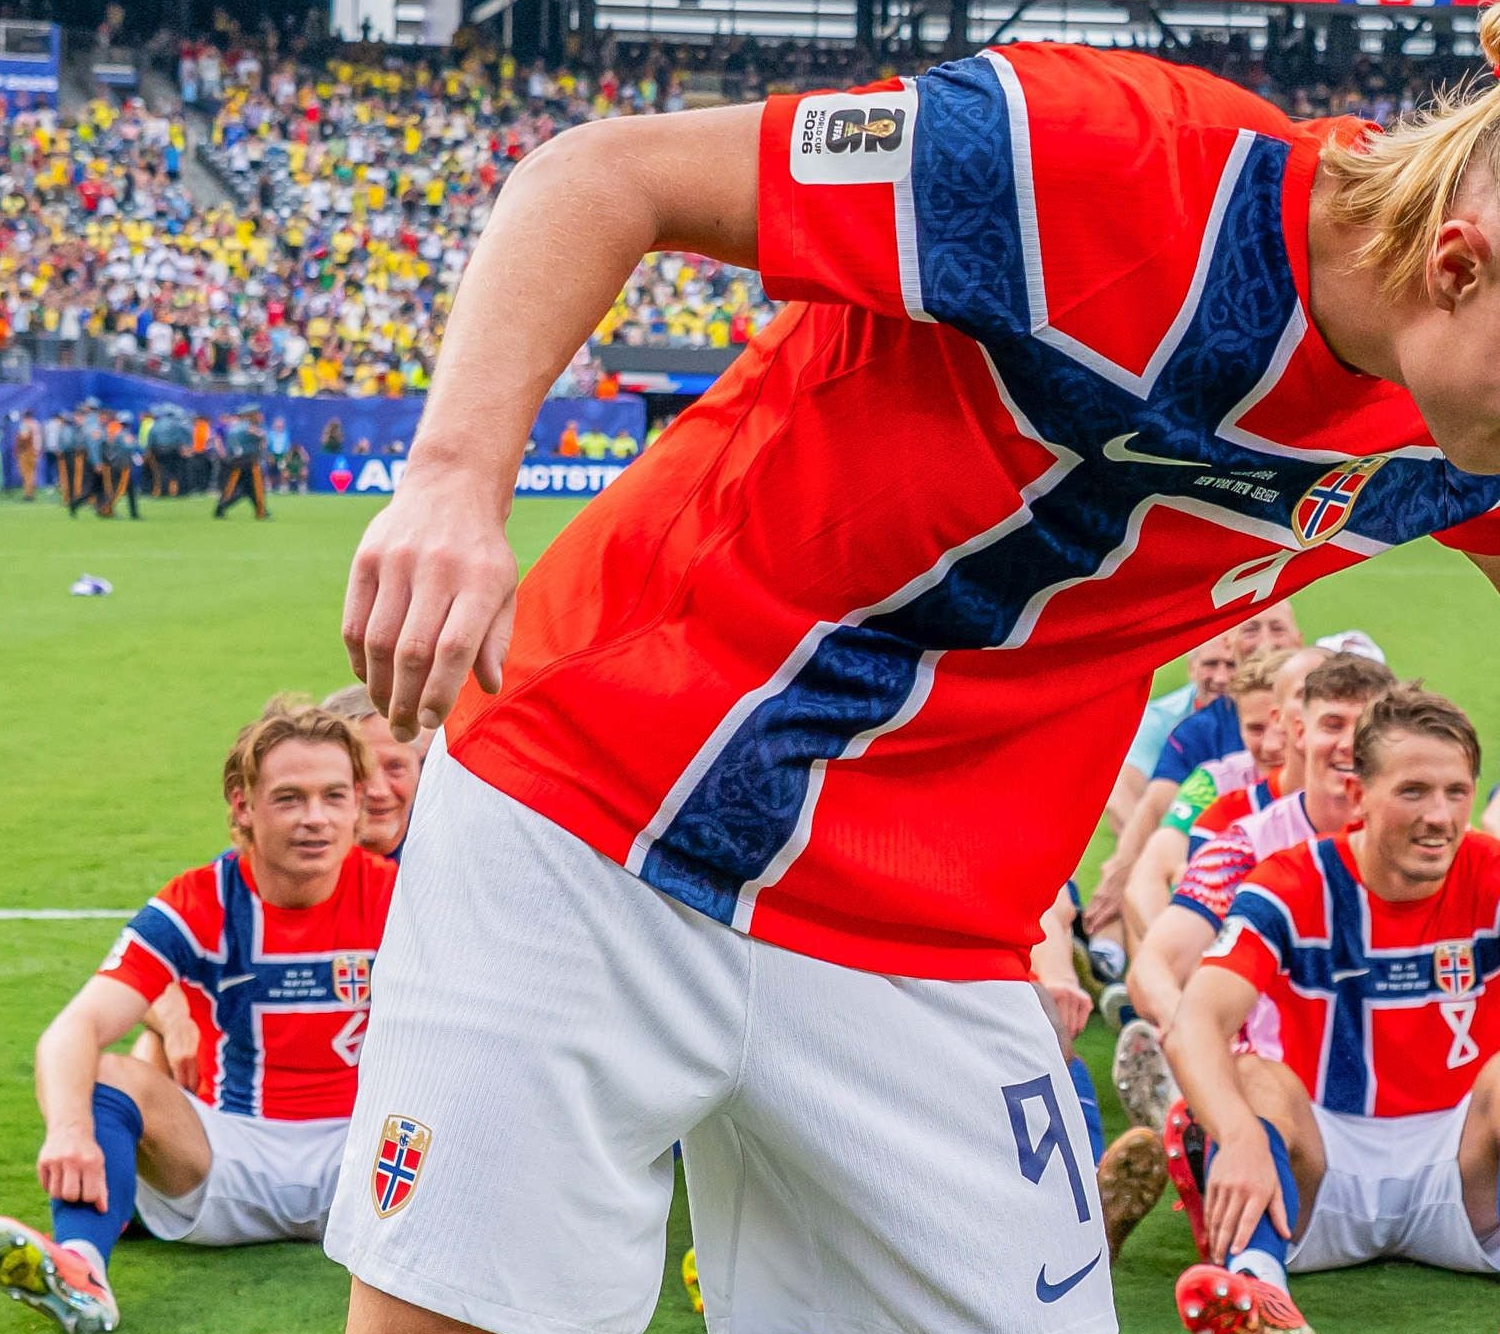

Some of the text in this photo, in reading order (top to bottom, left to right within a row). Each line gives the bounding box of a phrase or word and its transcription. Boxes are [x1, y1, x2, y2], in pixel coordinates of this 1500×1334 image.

[801, 110, 818, 155] 2026
[814, 110, 828, 155] WORLD CUP
[831, 120, 845, 141] FIFA
[1439, 1000, 1480, 1070] 8
[1000, 1073, 1092, 1224] 9
